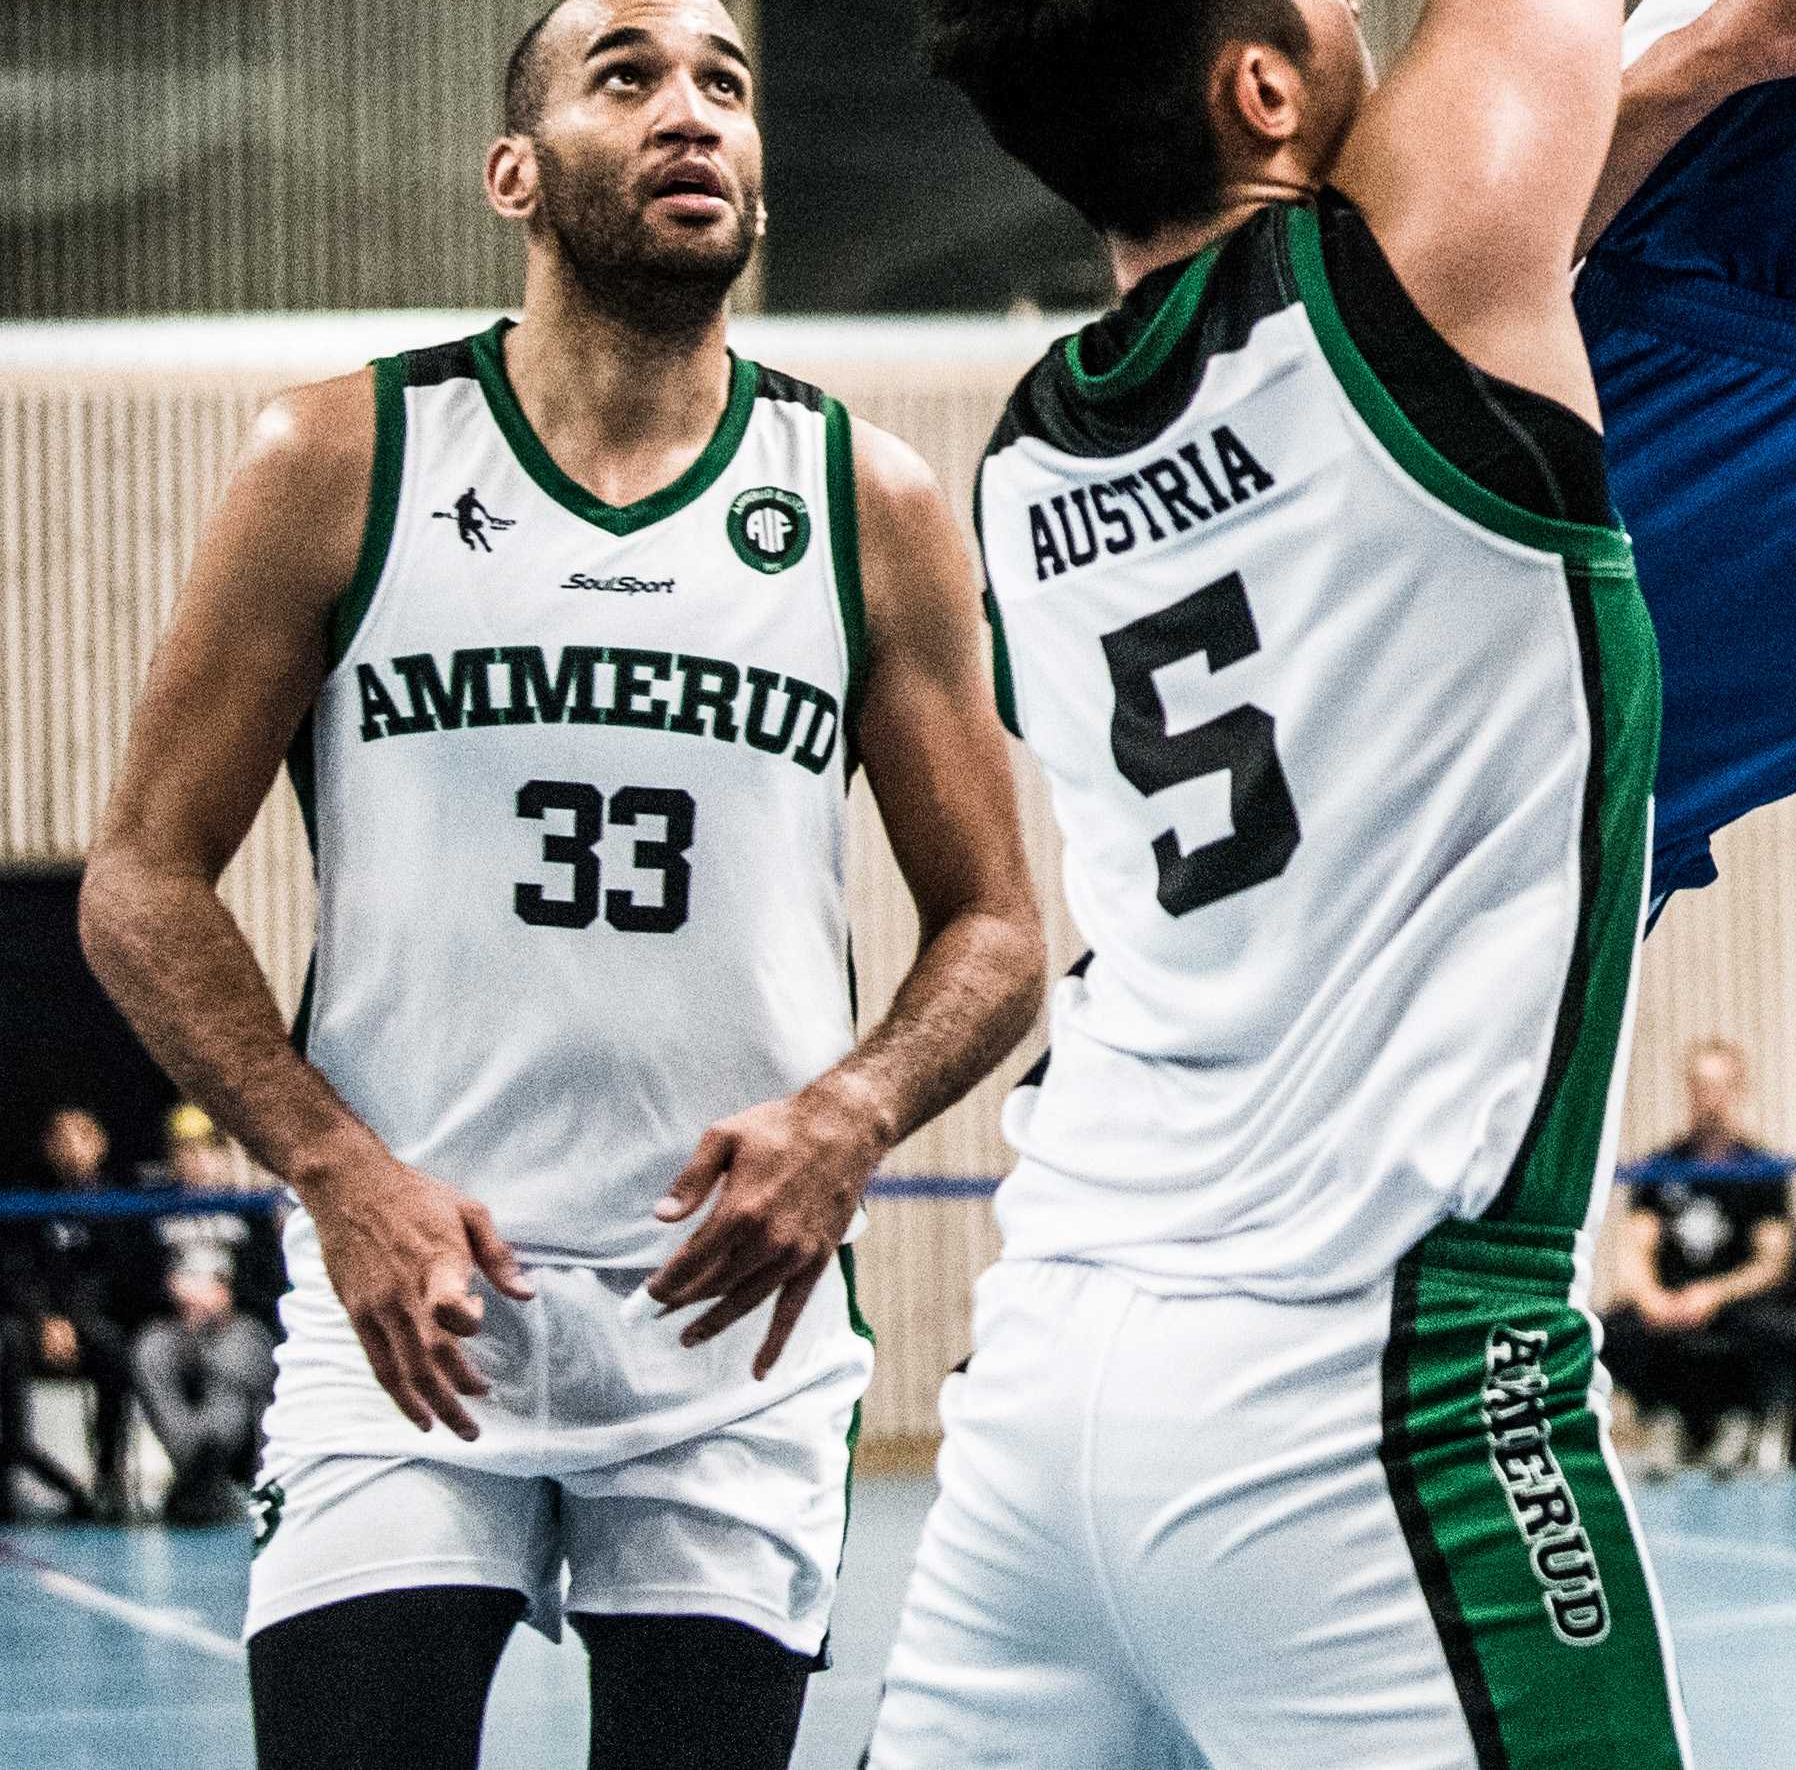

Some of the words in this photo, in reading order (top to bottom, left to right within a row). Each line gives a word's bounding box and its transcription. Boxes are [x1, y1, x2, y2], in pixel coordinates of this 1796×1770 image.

[1027, 425, 1276, 582] AUSTRIA
[559, 572, 676, 596] SoulSport
[356, 644, 840, 776] AMMERUD
[1100, 569, 1302, 919] 5
[513, 778, 697, 934] 33
